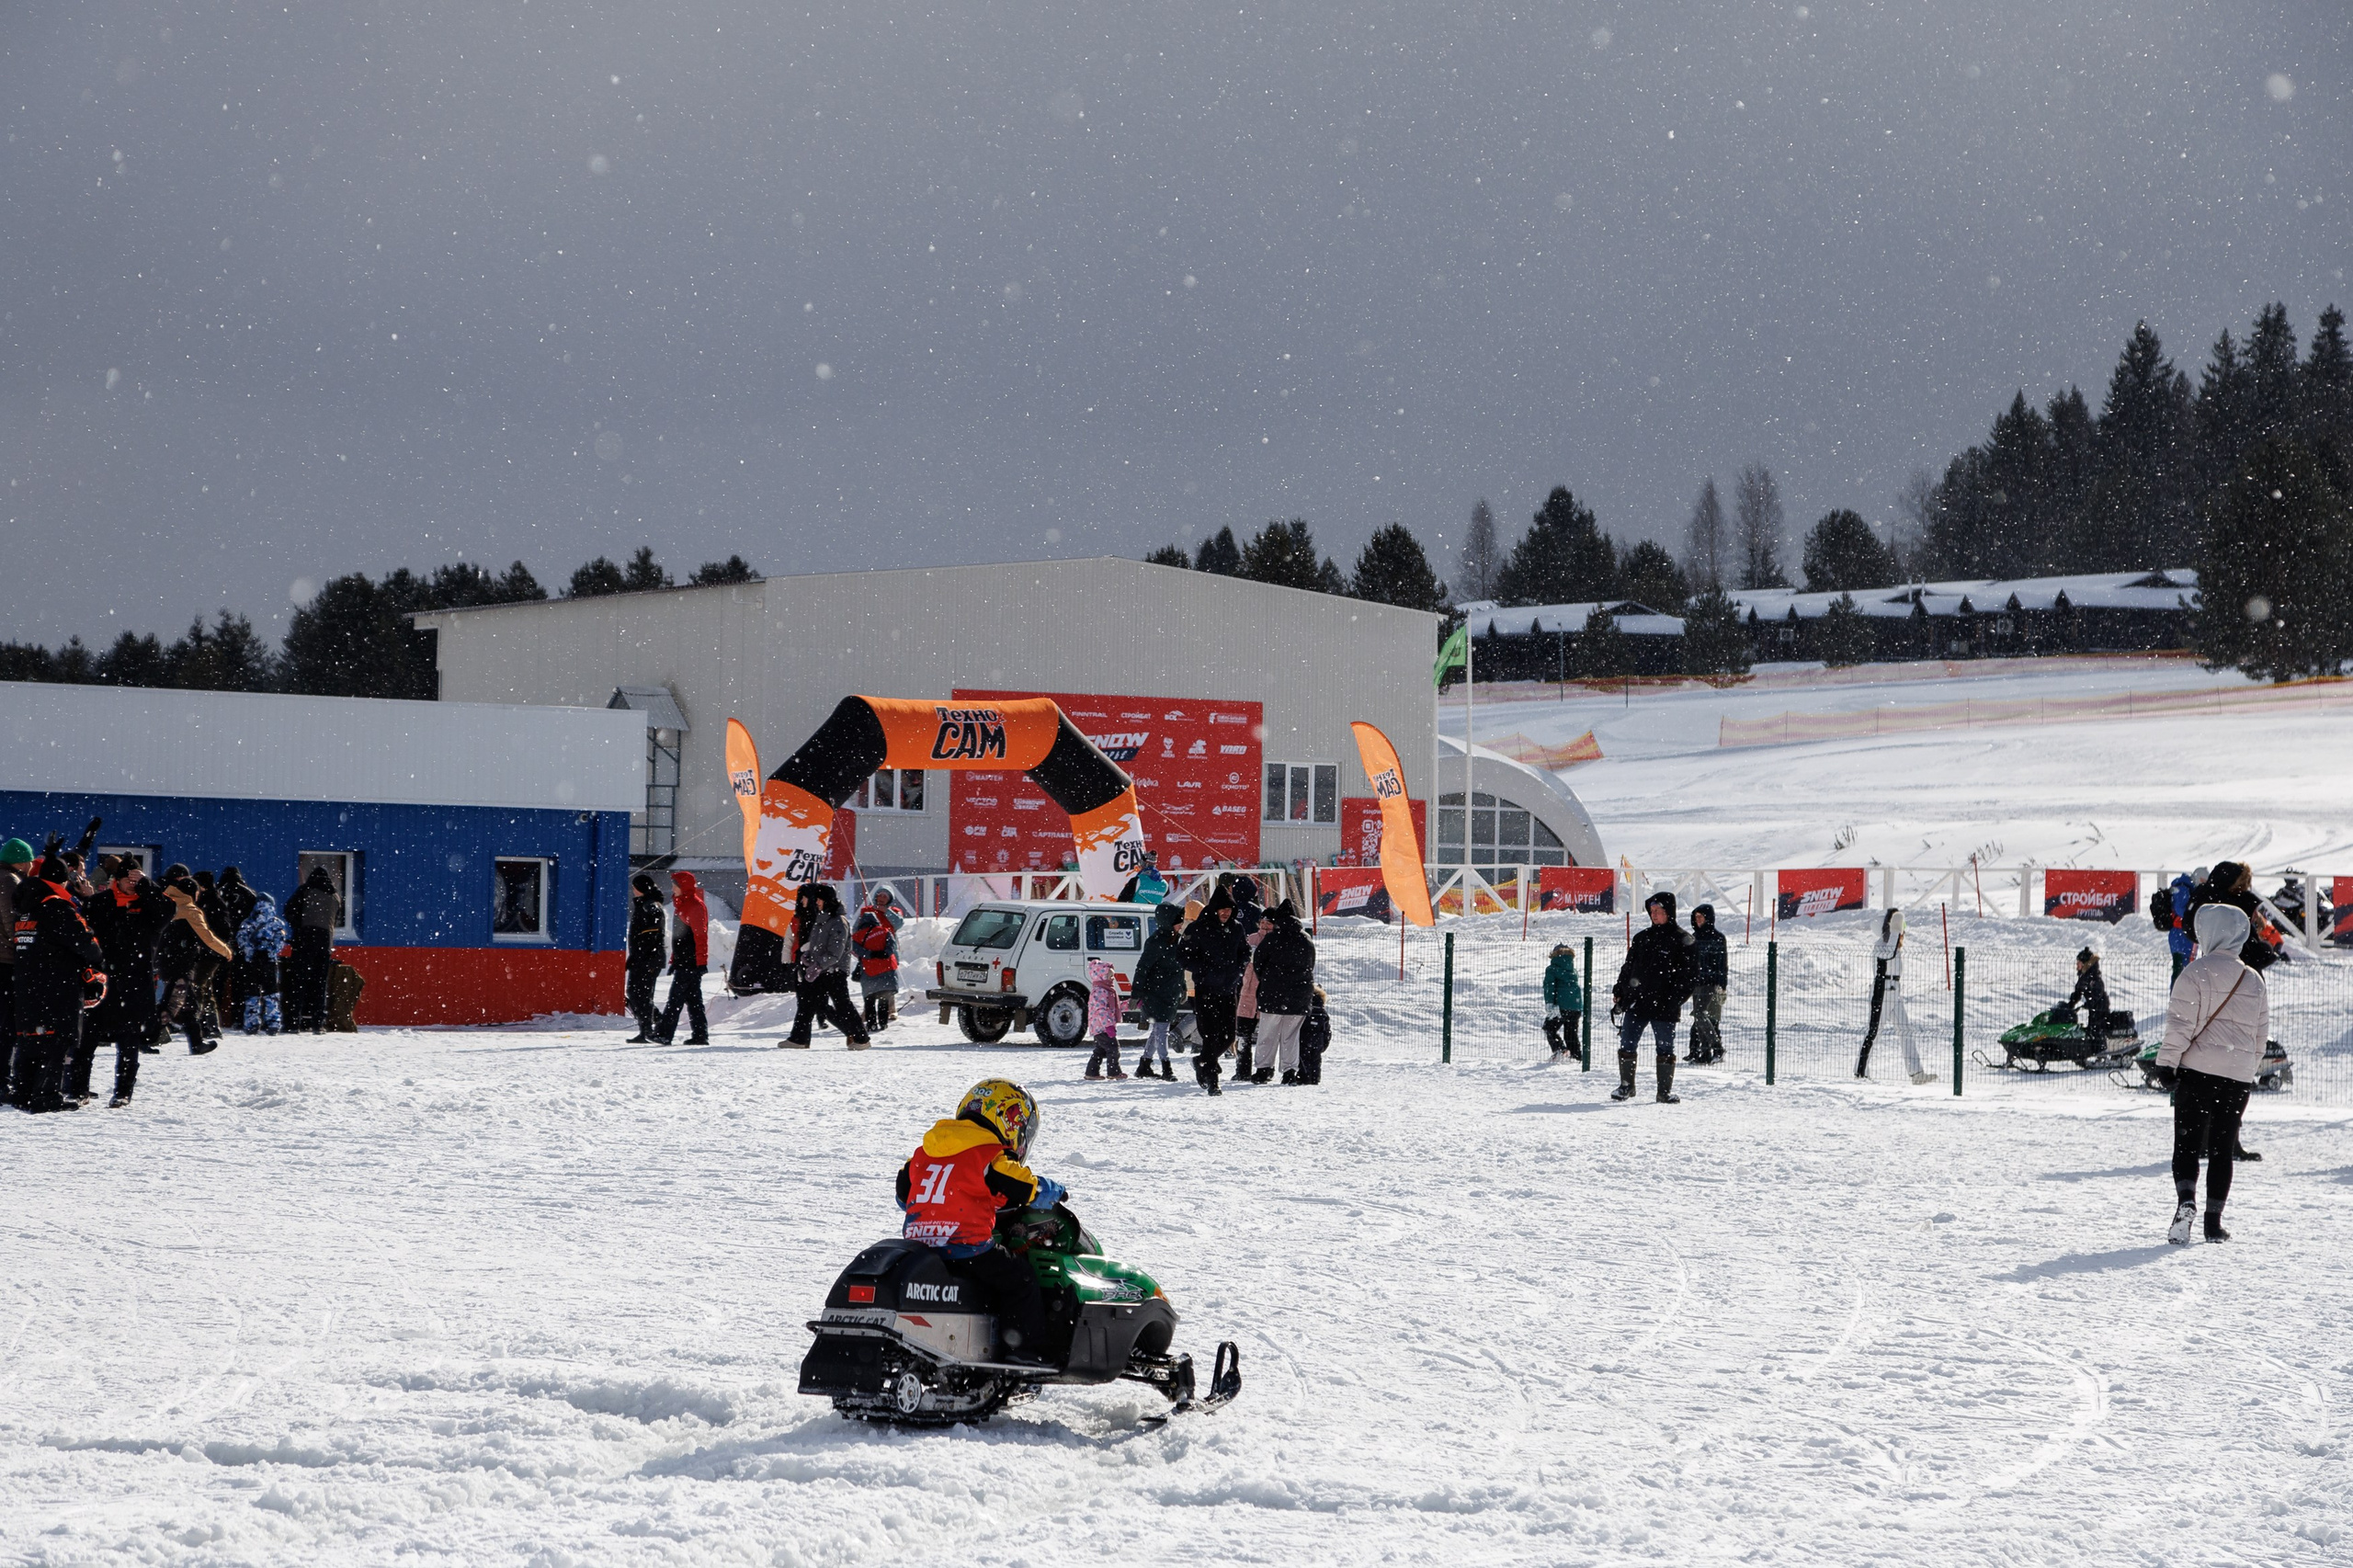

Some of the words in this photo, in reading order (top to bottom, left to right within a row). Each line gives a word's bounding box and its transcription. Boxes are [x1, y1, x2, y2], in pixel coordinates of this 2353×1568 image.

[935, 706, 999, 722] Техно
[931, 721, 1006, 759] САМ
[1114, 840, 1143, 852] Техн
[793, 847, 824, 862] Техн
[1113, 847, 1142, 873] СА
[1339, 884, 1373, 899] SNOW
[1564, 893, 1601, 905] МАРТЕН
[1801, 886, 1845, 903] SNOW
[2060, 888, 2120, 906] СТРОЙБАТ
[915, 1164, 955, 1205] 31
[904, 1224, 960, 1239] SNOW
[906, 1282, 939, 1301] ARCTIC
[941, 1285, 960, 1302] CAT
